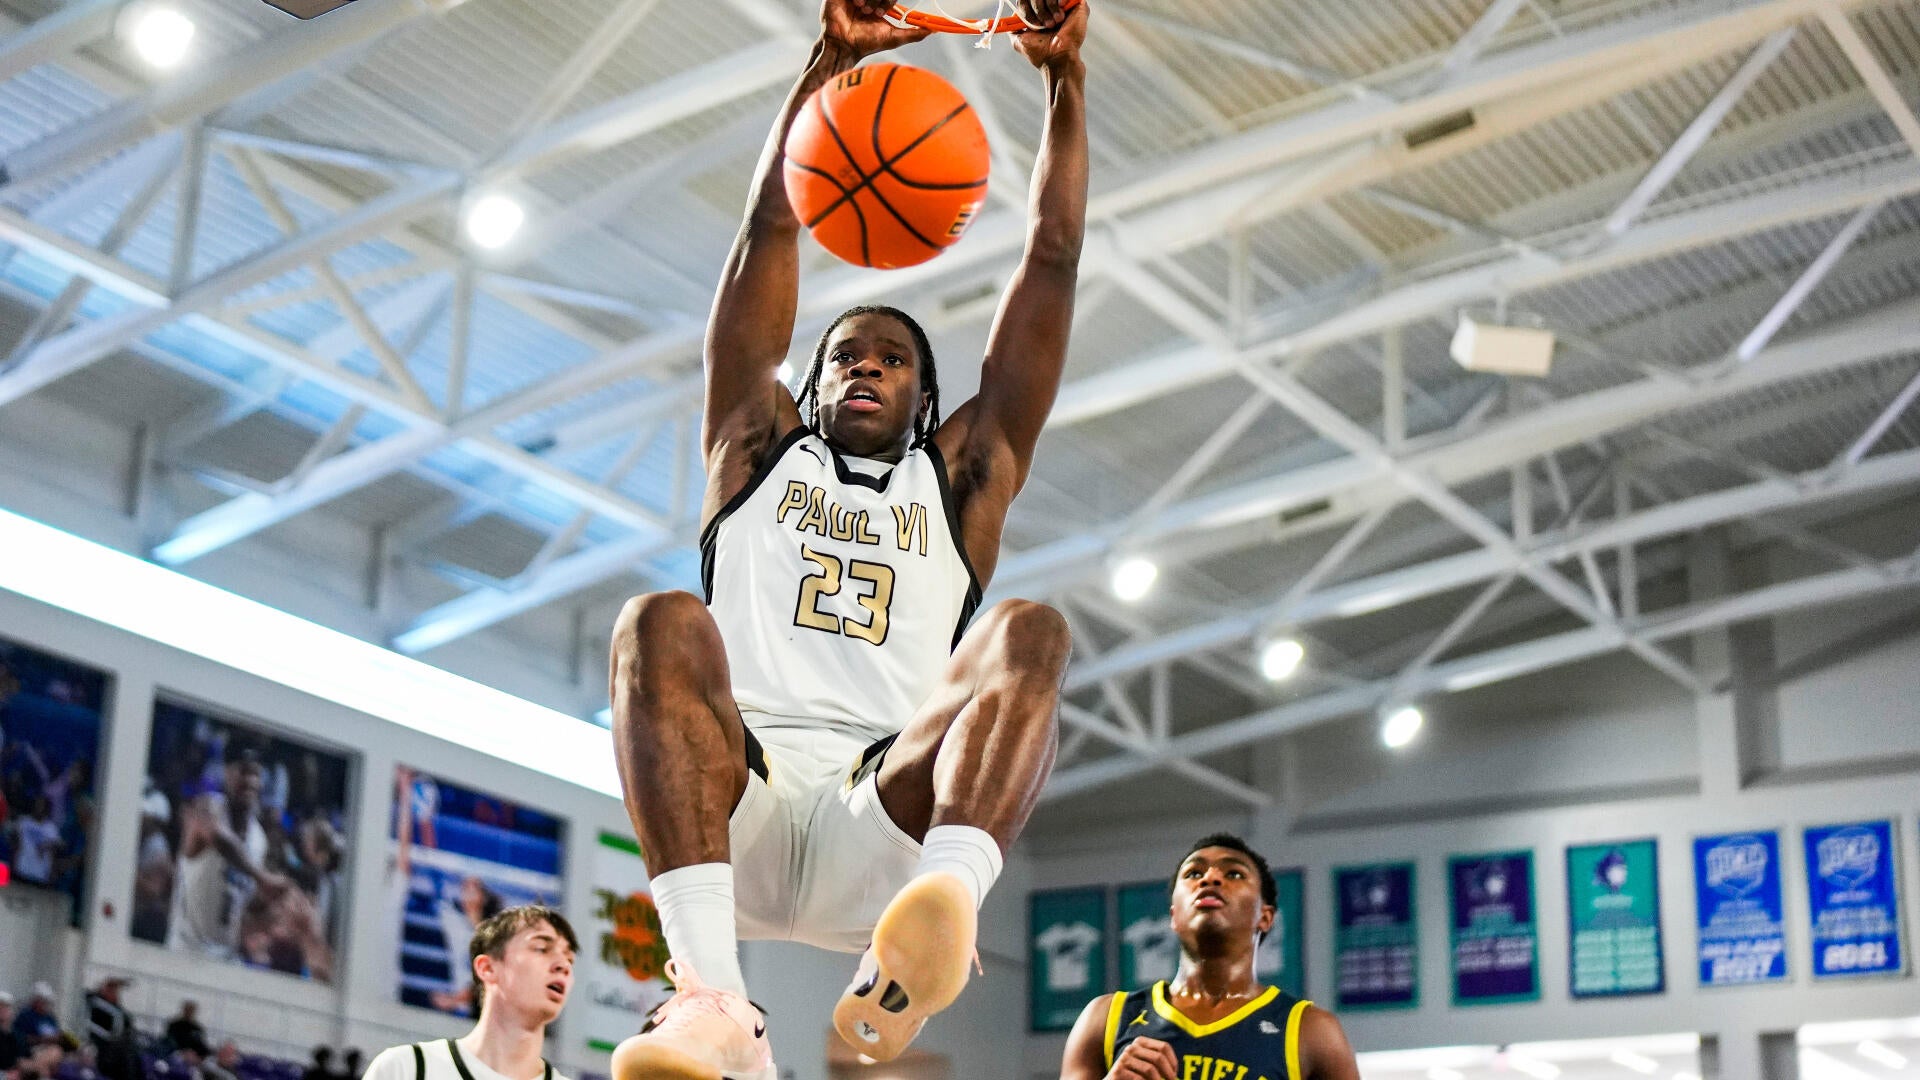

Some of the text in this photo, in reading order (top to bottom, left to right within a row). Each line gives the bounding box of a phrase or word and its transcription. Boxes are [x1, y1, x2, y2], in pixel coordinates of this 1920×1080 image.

[777, 480, 928, 556] PAUL VI
[793, 542, 895, 646] 23
[1183, 1054, 1268, 1080] FIEL
